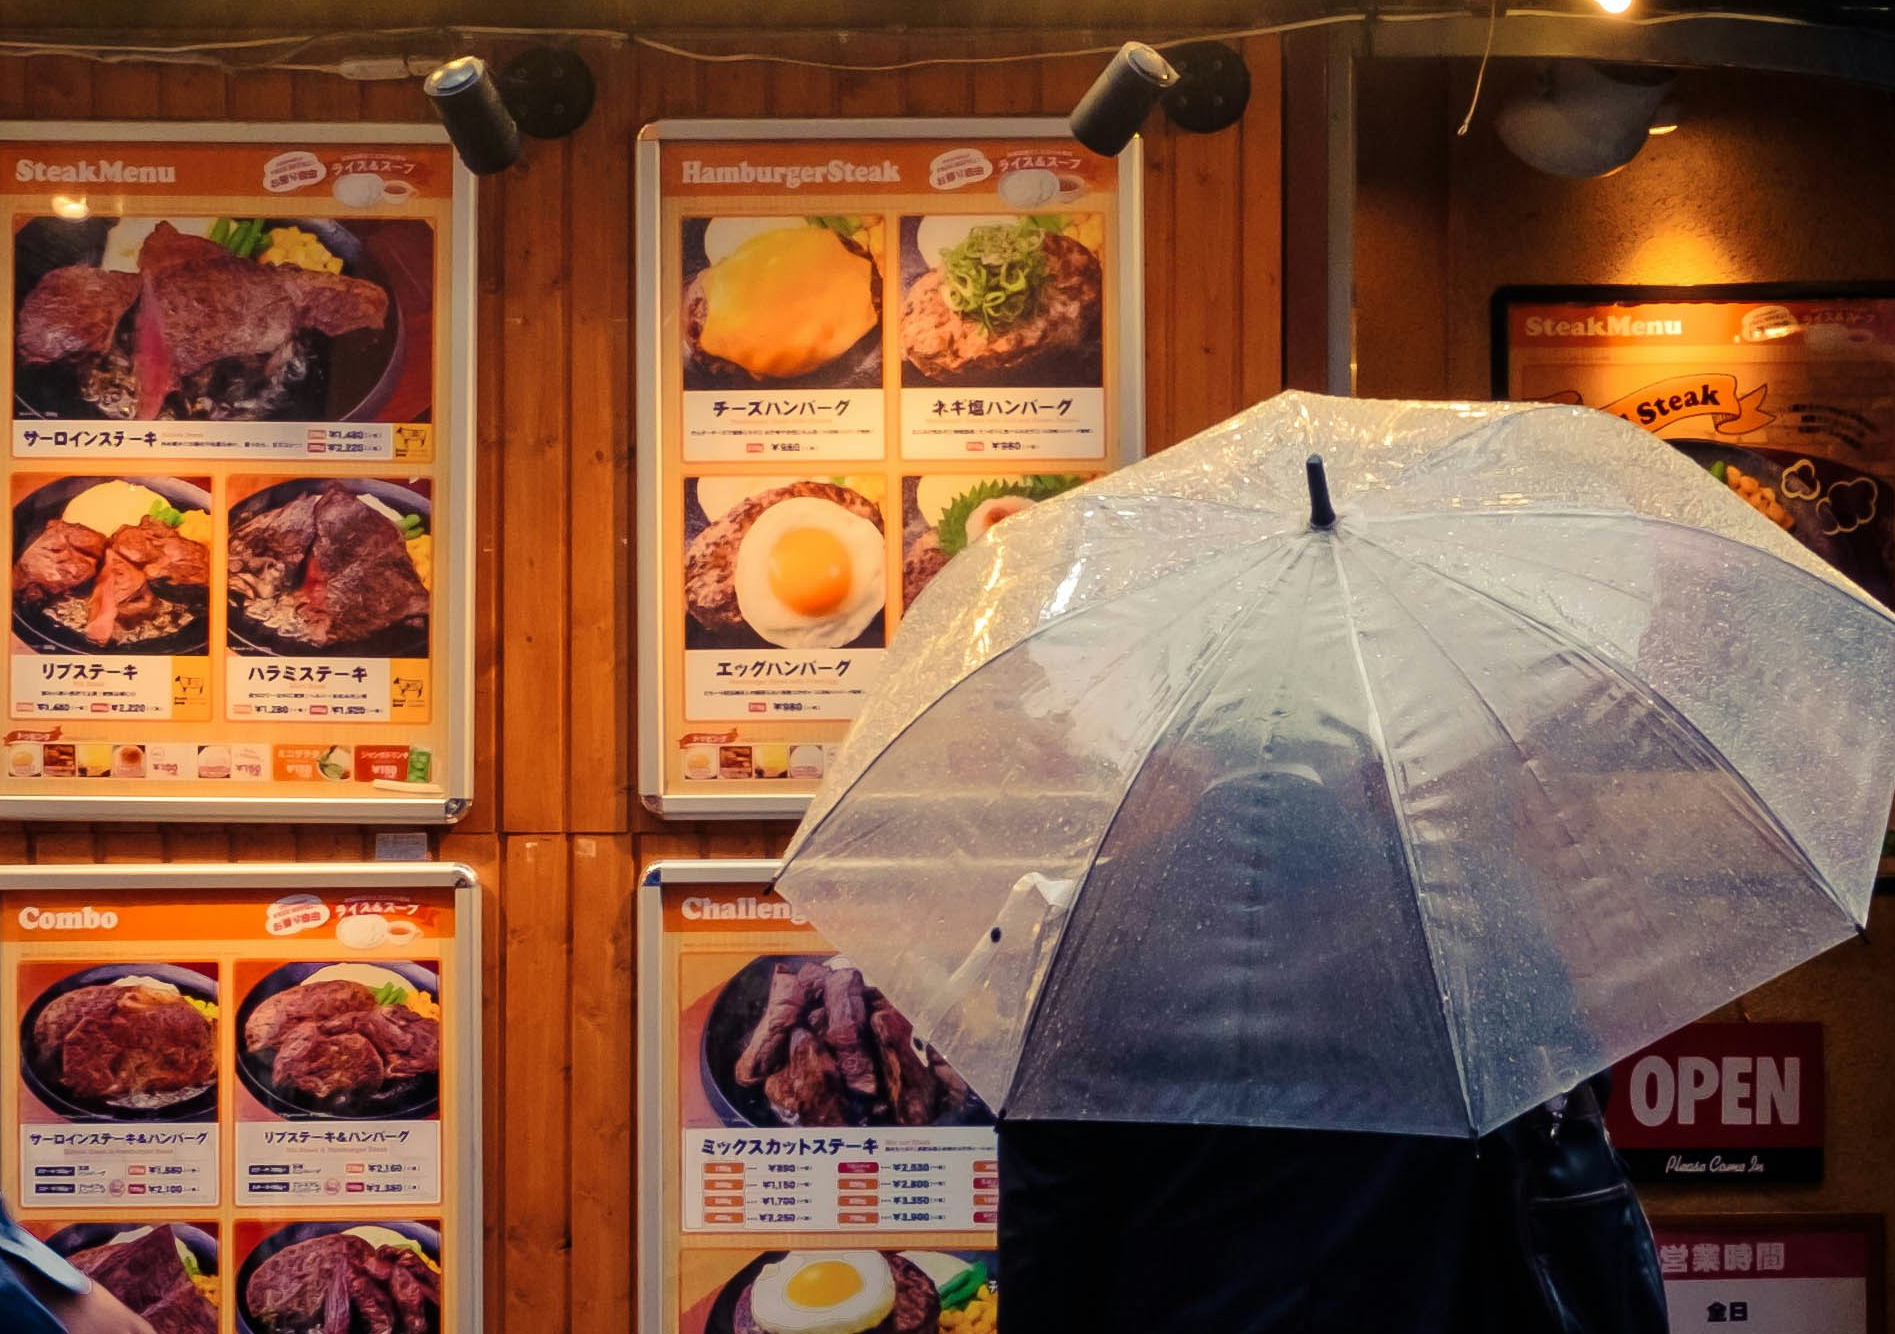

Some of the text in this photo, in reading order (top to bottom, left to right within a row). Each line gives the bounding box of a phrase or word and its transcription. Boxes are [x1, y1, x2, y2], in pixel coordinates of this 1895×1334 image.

[712, 399, 851, 418] チーズハンバーグ
[932, 398, 1074, 417] ネギ塩ハンバーグ
[1637, 384, 1721, 426] Steak
[23, 430, 157, 448] サーロインステーキ
[42, 663, 139, 681] リブステーキ
[248, 665, 369, 684] ハラミステーキ
[716, 660, 852, 678] エッグハンバーグ
[18, 906, 119, 930] Combo
[1629, 1055, 1801, 1127] OPEN
[701, 1138, 879, 1156] ミックスカットステーキ
[1661, 1242, 1786, 1274] 営業時間
[1706, 1301, 1749, 1323] 全日
